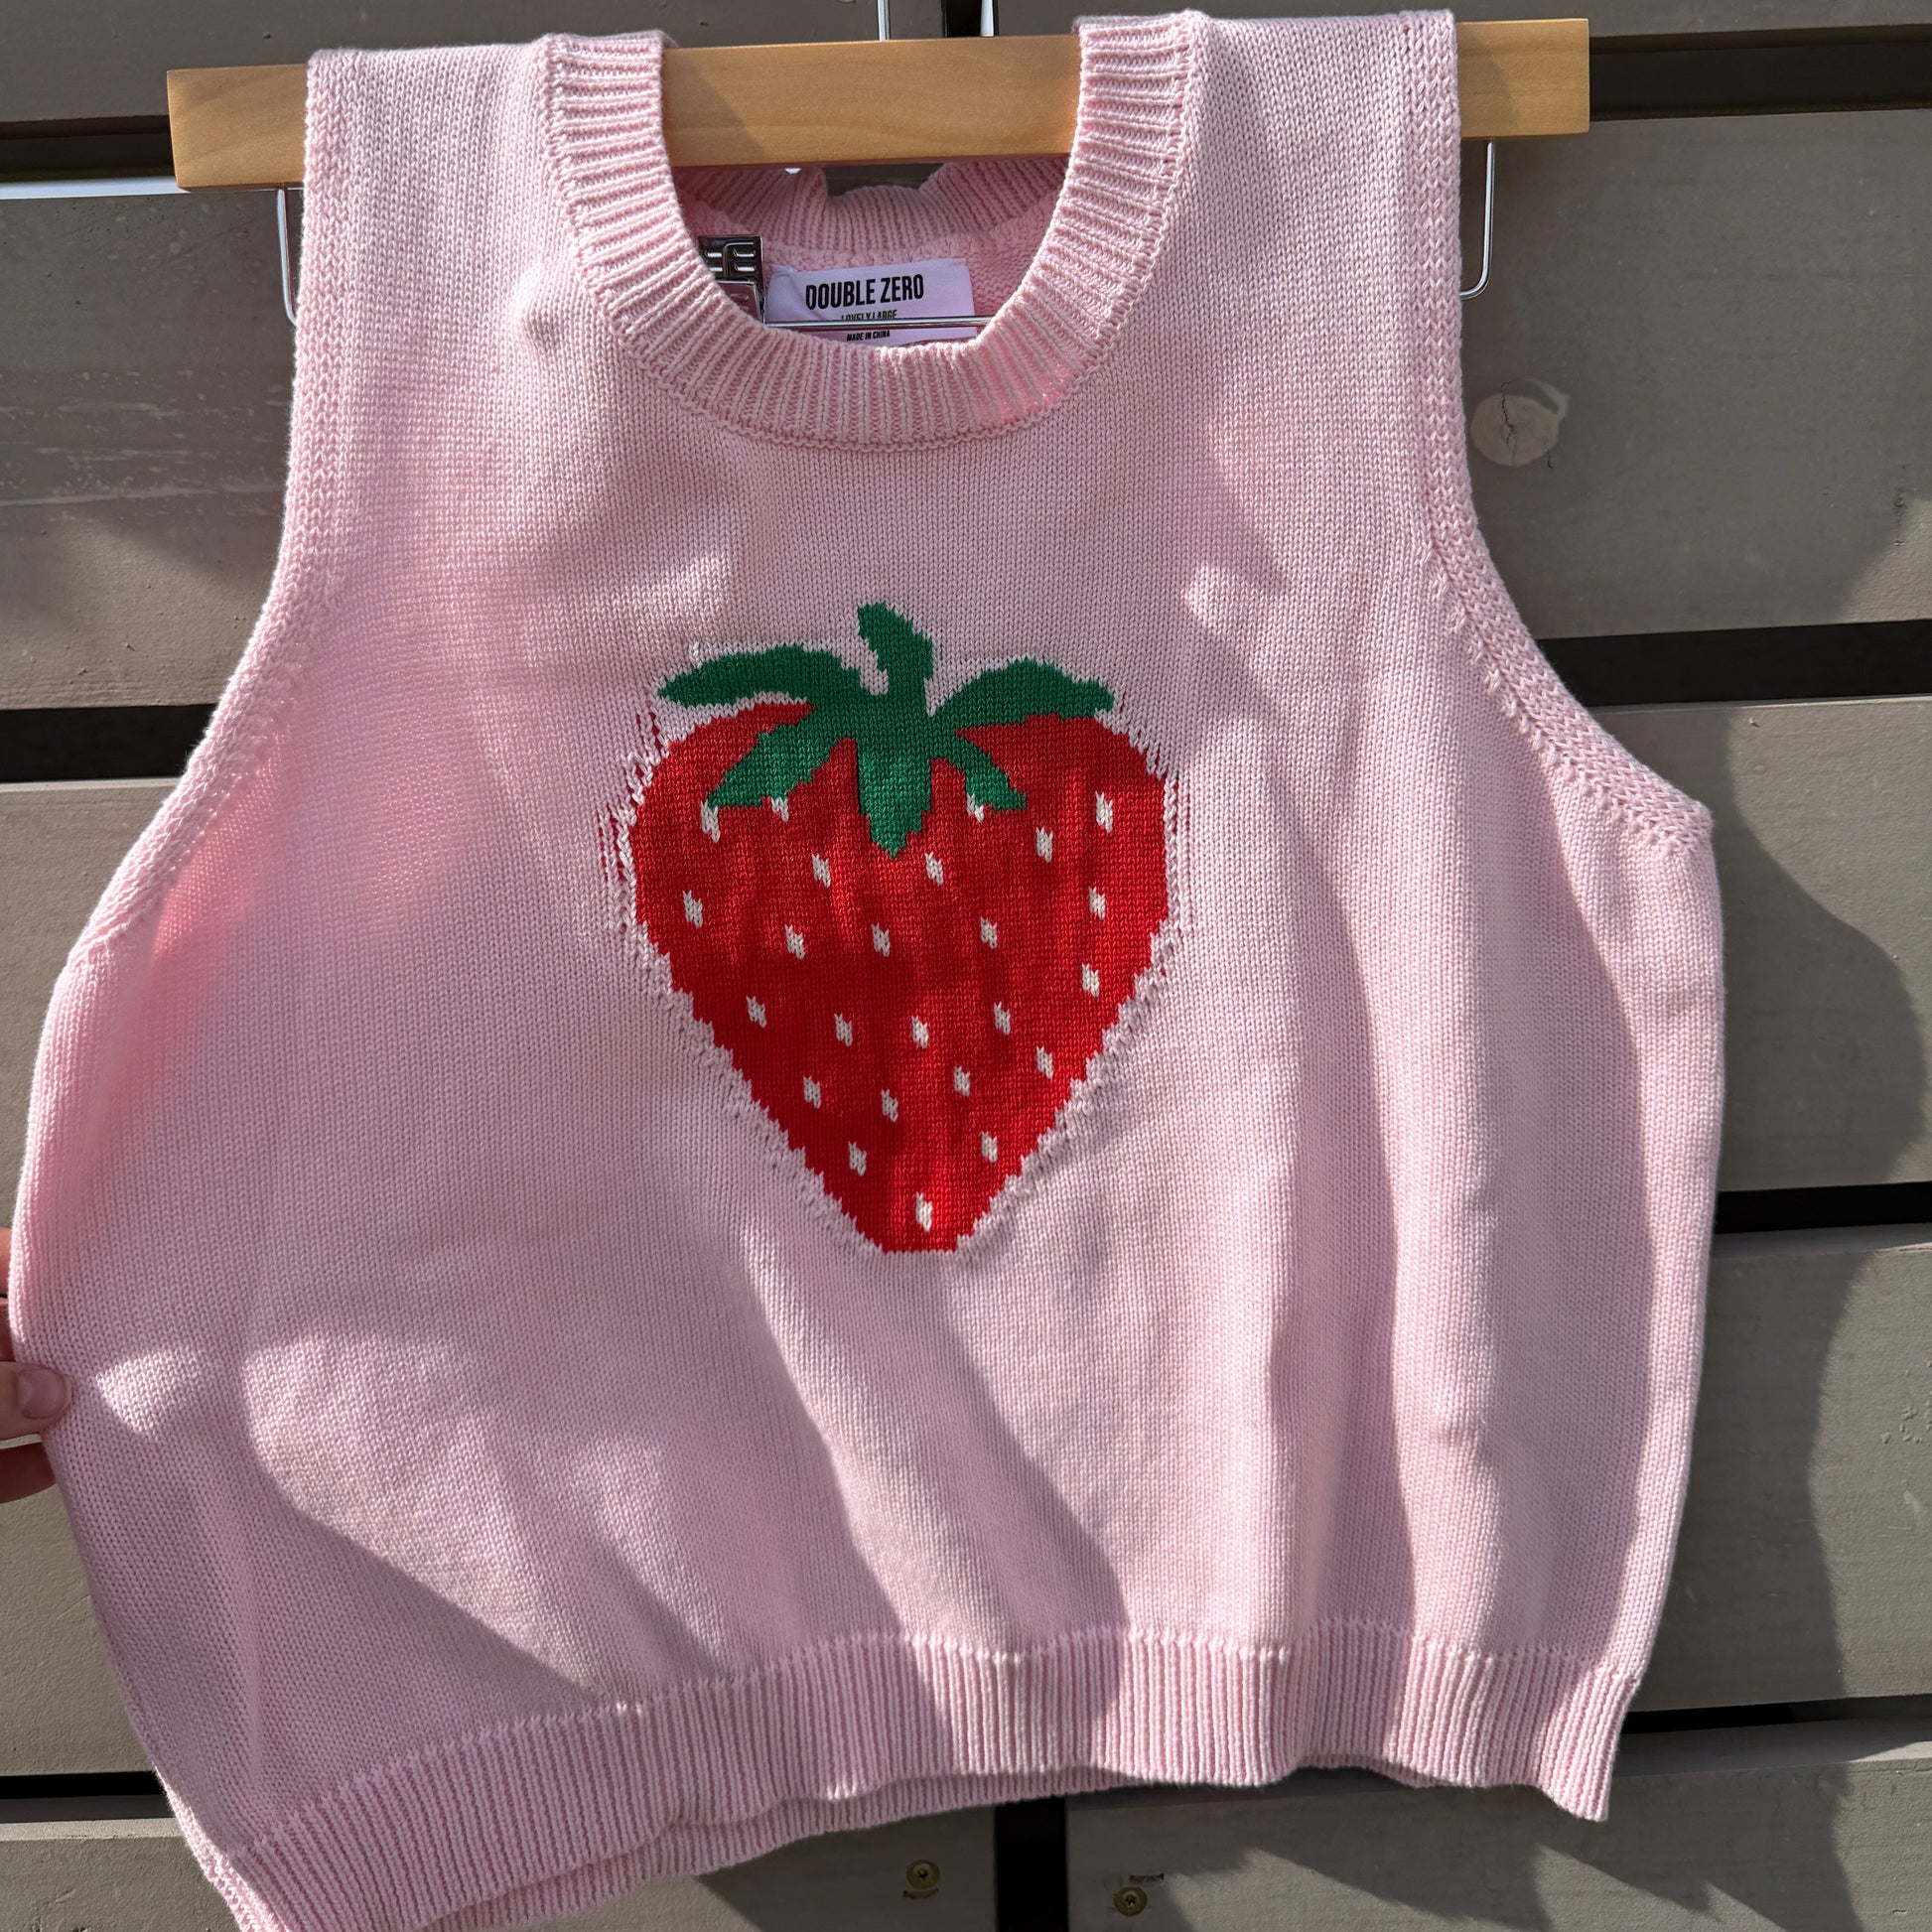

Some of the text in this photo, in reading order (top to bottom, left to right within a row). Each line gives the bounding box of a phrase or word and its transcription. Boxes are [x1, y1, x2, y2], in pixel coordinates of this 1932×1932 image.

[805, 274, 924, 310] DOUBLE ZERO
[846, 332, 864, 342] MADE
[873, 330, 891, 340] CHINA
